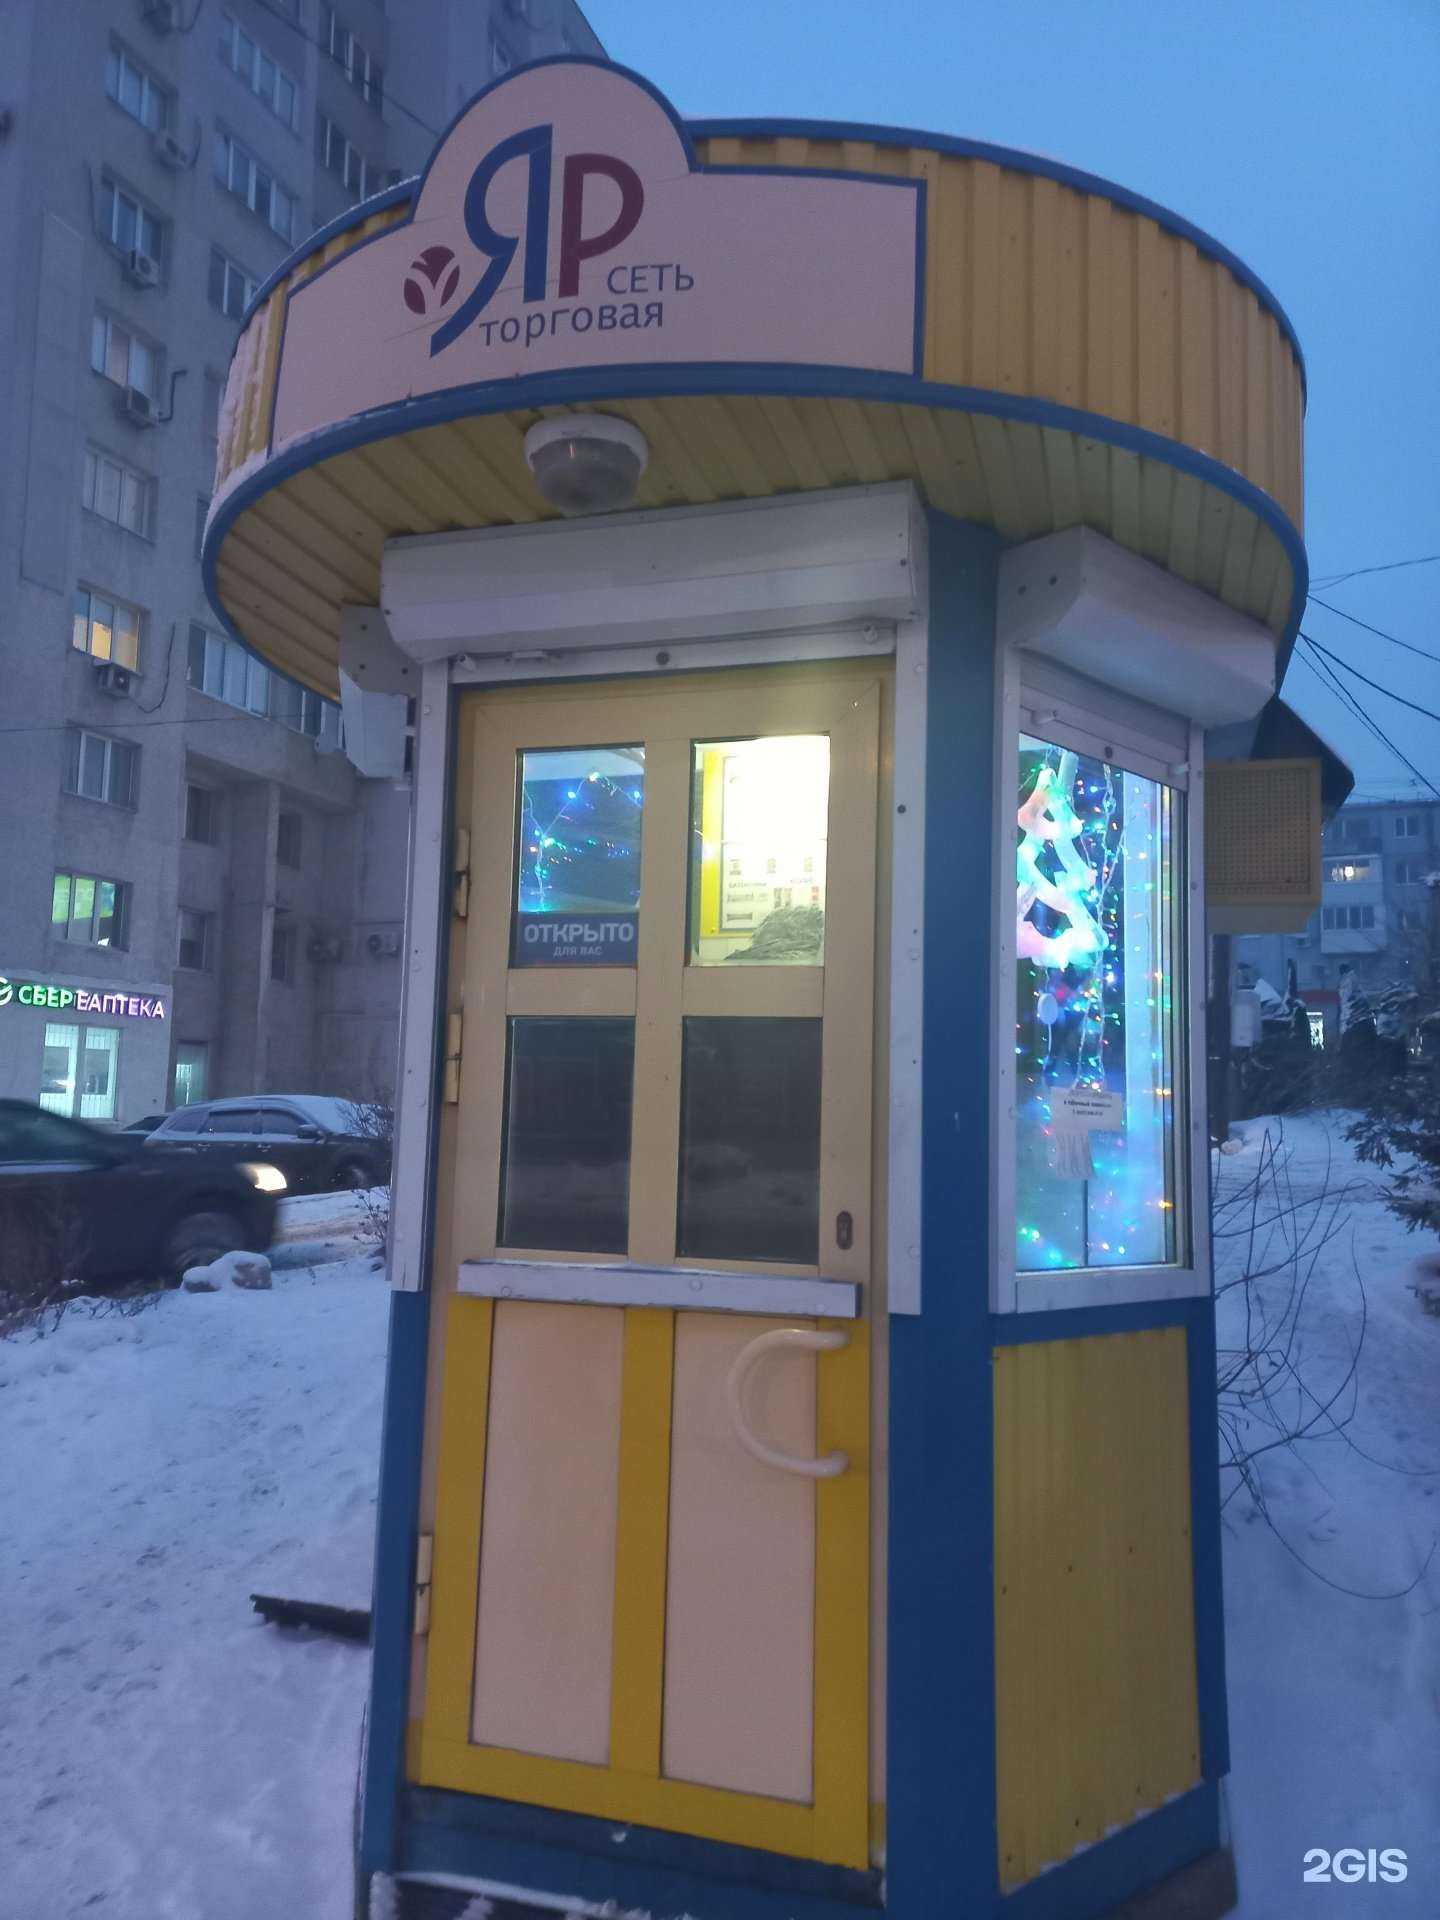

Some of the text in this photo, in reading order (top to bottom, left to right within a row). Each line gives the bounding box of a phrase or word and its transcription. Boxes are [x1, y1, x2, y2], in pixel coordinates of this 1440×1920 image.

[429, 122, 645, 359] ЯР
[478, 301, 664, 348] торговая
[523, 922, 635, 943] ОТКРЫТО
[553, 946, 577, 957] ДЛЯ
